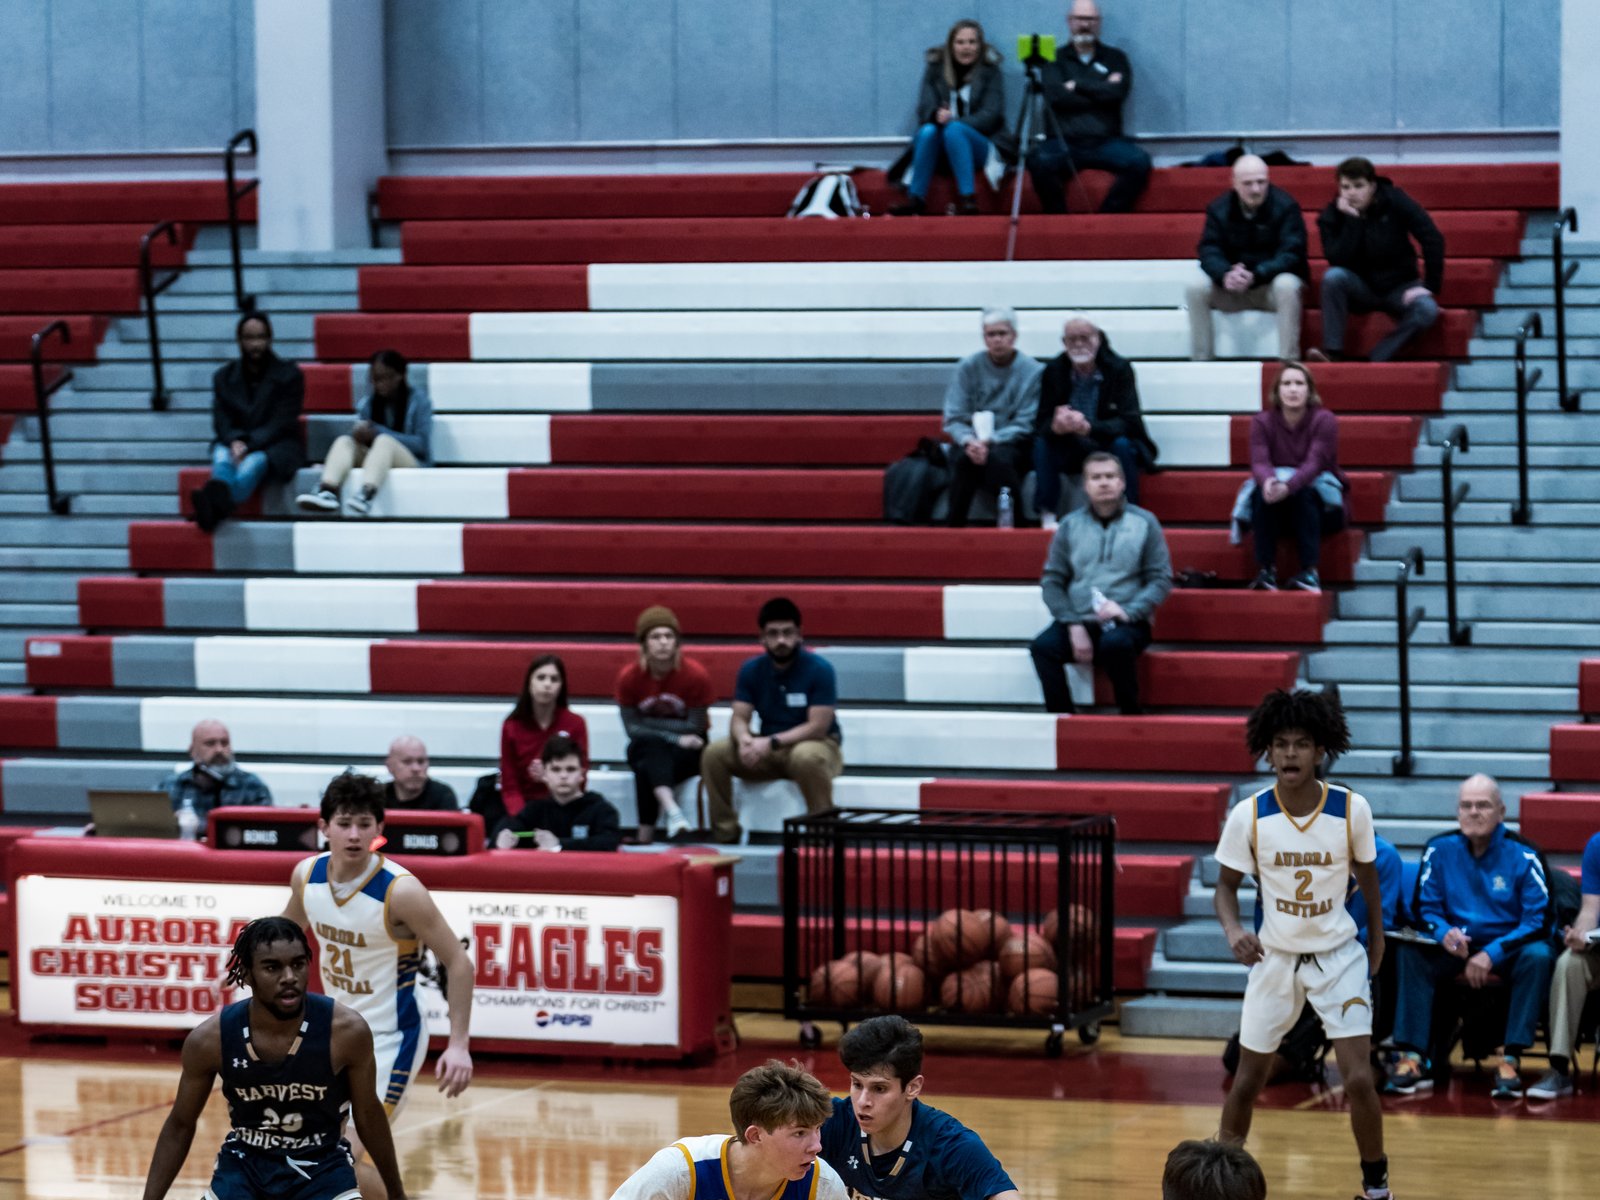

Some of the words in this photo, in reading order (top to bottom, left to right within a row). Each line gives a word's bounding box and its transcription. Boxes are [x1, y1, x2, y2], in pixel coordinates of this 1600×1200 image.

[1274, 851, 1333, 867] AURORA
[1294, 870, 1313, 901] 2
[102, 894, 188, 909] WELCOME
[195, 895, 217, 909] TO
[468, 902, 520, 917] HOME
[526, 904, 549, 918] OF
[555, 905, 589, 920] THE
[30, 948, 240, 981] CHRISTI
[326, 943, 354, 978] 21
[472, 921, 664, 996] EAGLES
[569, 997, 600, 1011] FOR
[550, 1013, 592, 1026] PEPSI
